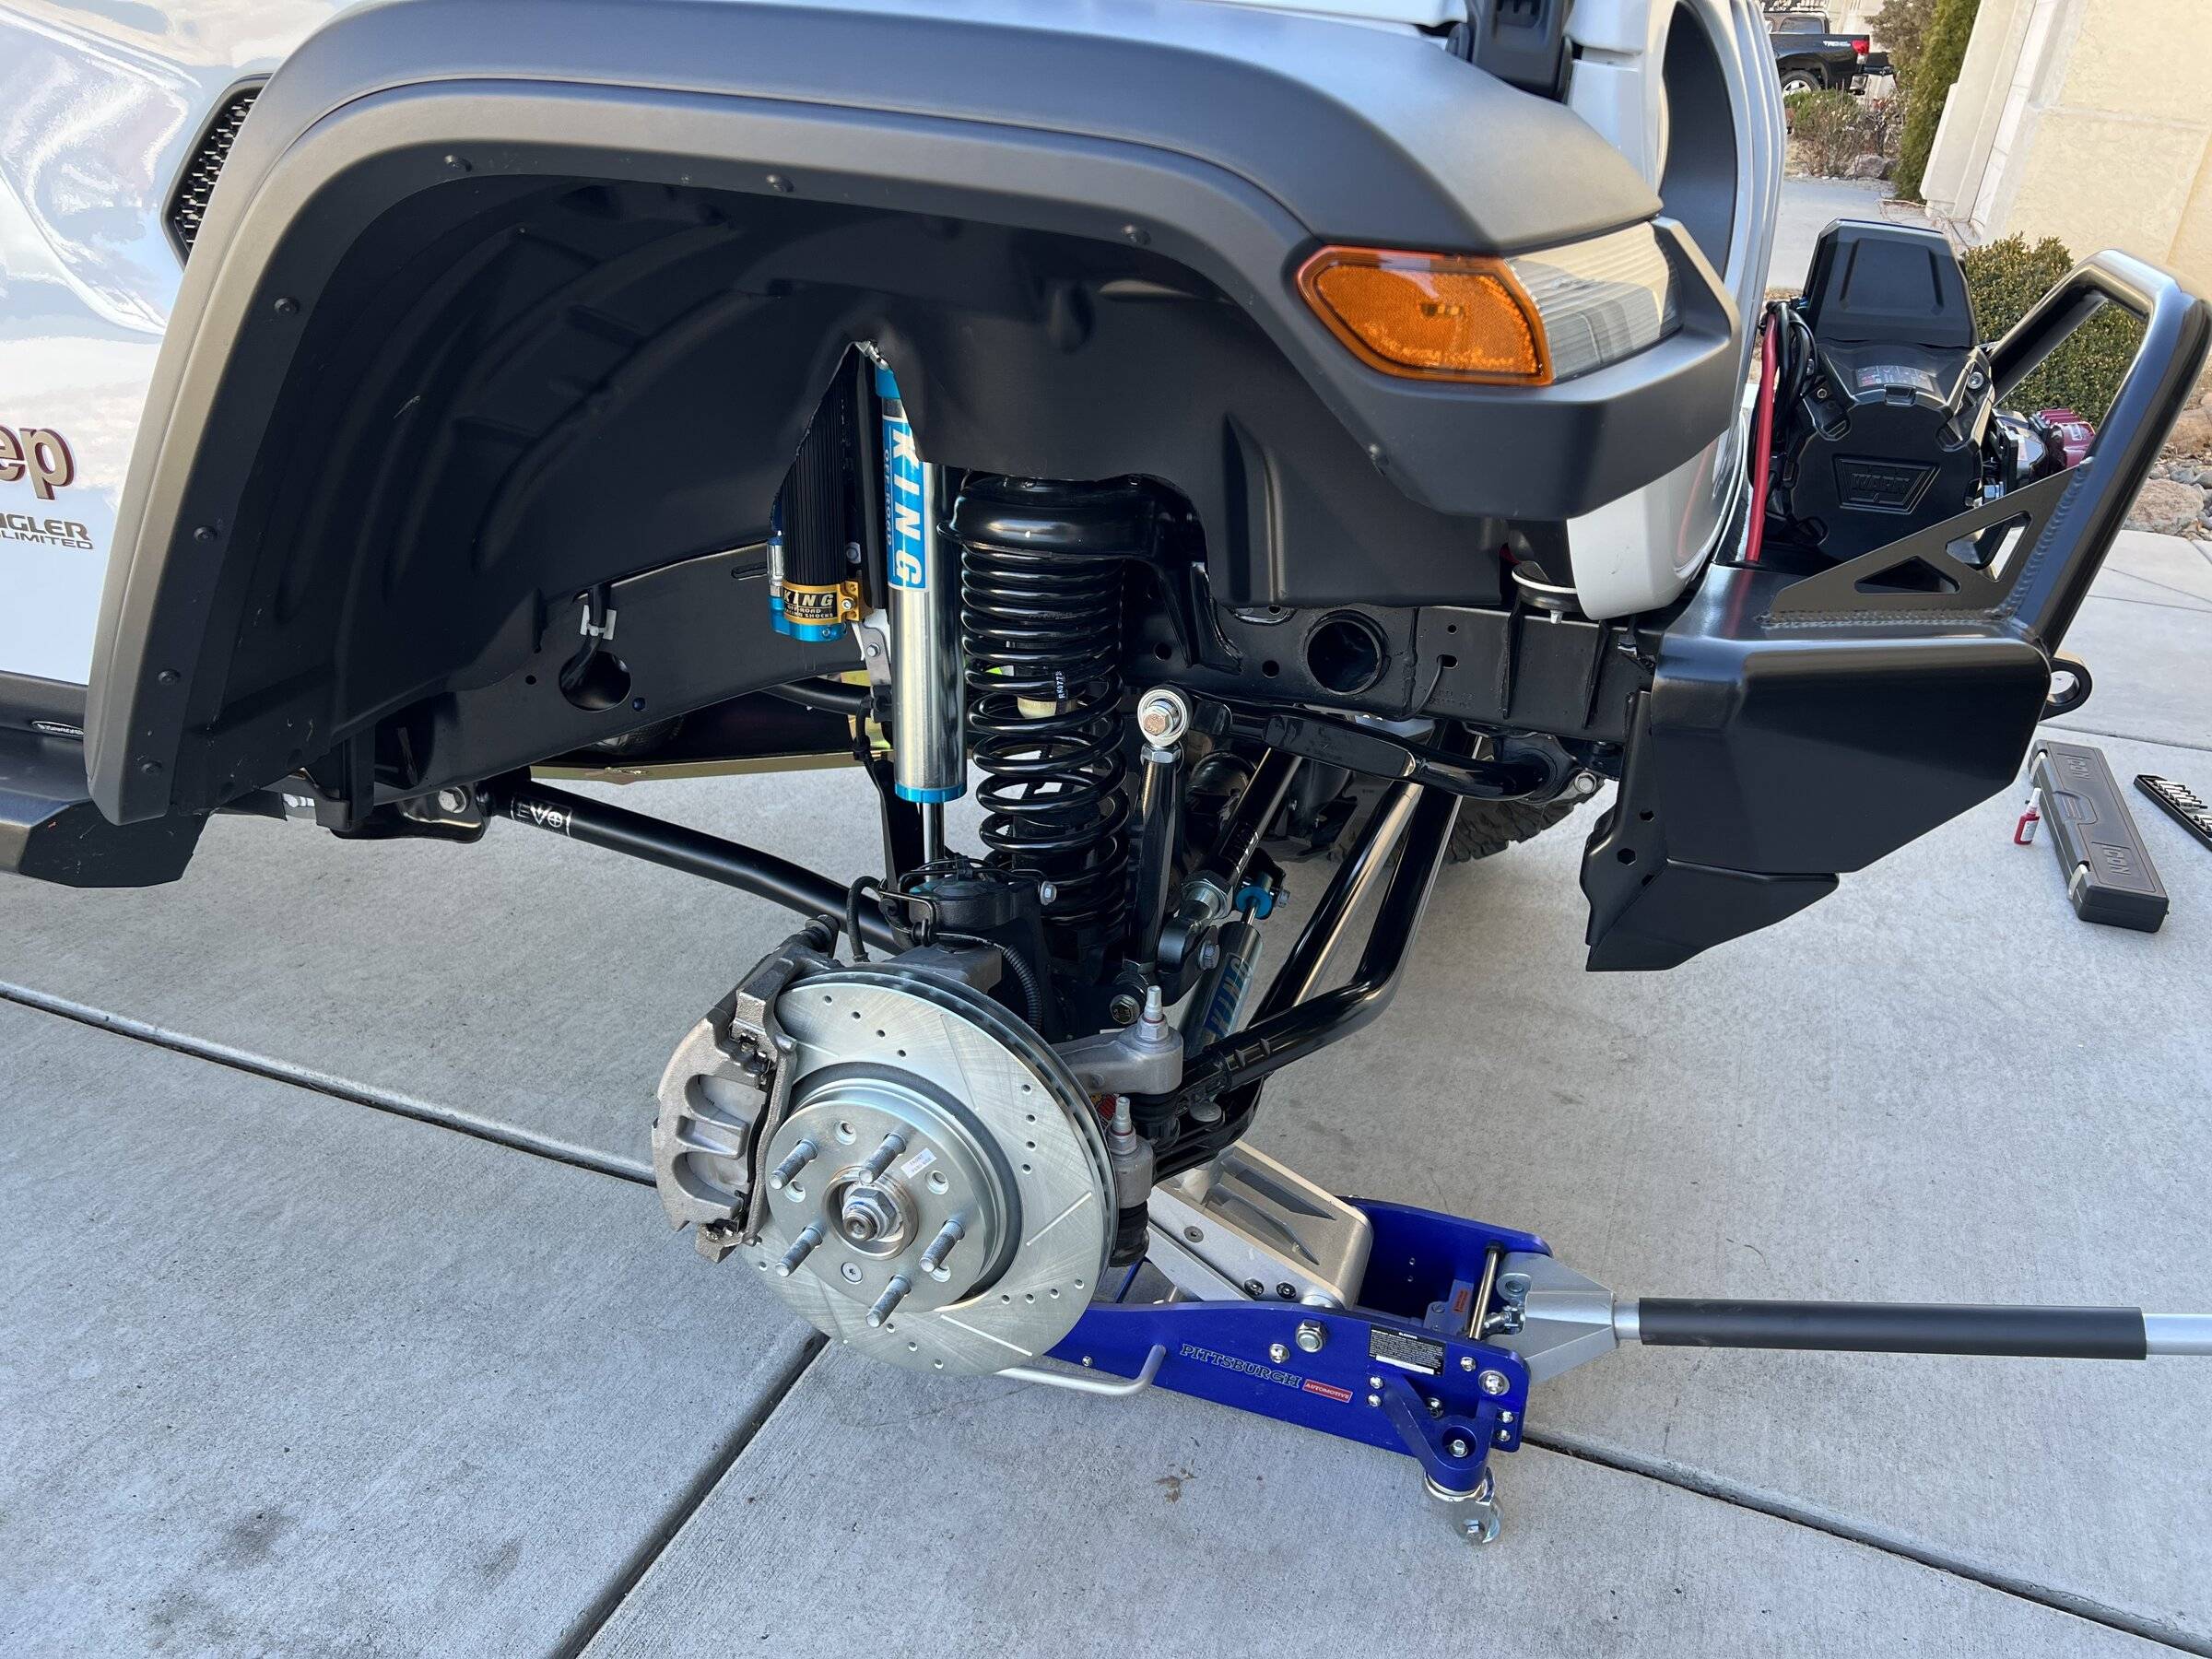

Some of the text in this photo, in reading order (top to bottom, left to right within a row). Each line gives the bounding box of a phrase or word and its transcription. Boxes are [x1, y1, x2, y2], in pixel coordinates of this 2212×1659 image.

[892, 429, 922, 585] KING
[784, 590, 834, 606] KING
[2090, 841, 2132, 876] ICON
[1180, 1343, 1302, 1389] PITTSBURGH
[1304, 1382, 1350, 1400] AUTOMOTIVE
